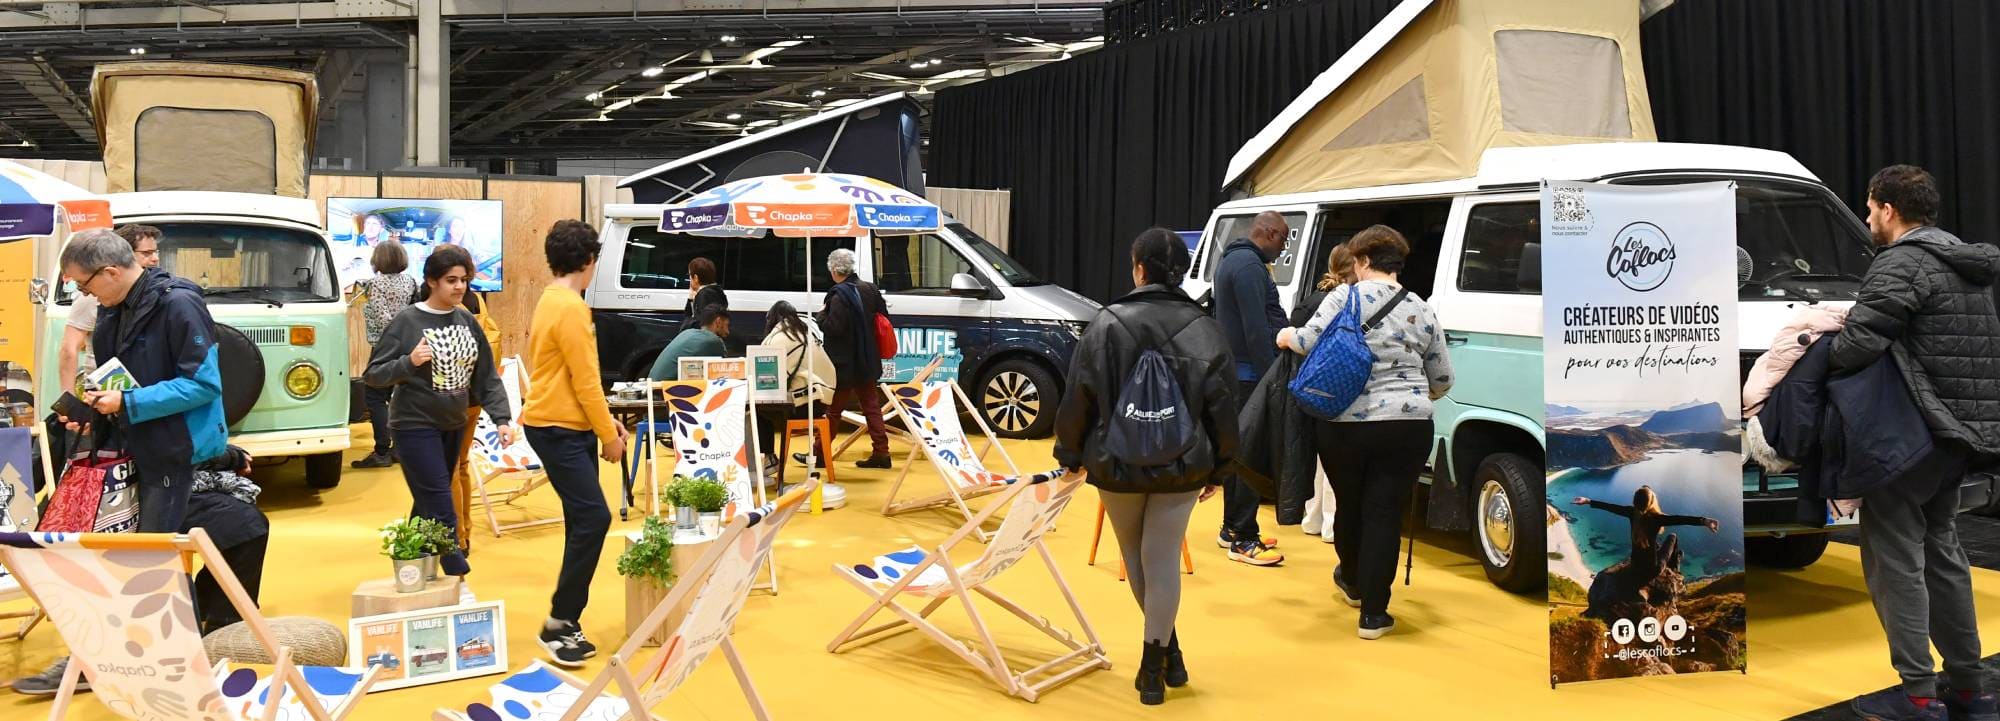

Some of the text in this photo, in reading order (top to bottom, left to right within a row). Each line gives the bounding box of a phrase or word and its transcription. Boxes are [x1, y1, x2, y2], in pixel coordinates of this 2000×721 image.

[686, 213, 712, 225] Chapka
[769, 210, 813, 222] Chapka
[878, 212, 911, 223] Chapka
[1623, 236, 1643, 252] Les
[1606, 244, 1676, 278] Coflocs
[1563, 302, 1720, 326] CRÉATEURS DE VIDÉOS
[893, 330, 957, 355] ANLIFE
[1563, 327, 1720, 344] AUTHENTIQUES & INSPIRANTES
[1564, 344, 1719, 379] pour vos destinations
[699, 451, 731, 461] Chapka
[412, 619, 443, 630] VANLIFE
[459, 611, 489, 624] VANLIFE
[367, 623, 397, 636] VANLIFE
[1618, 645, 1682, 661] @lescoflocs
